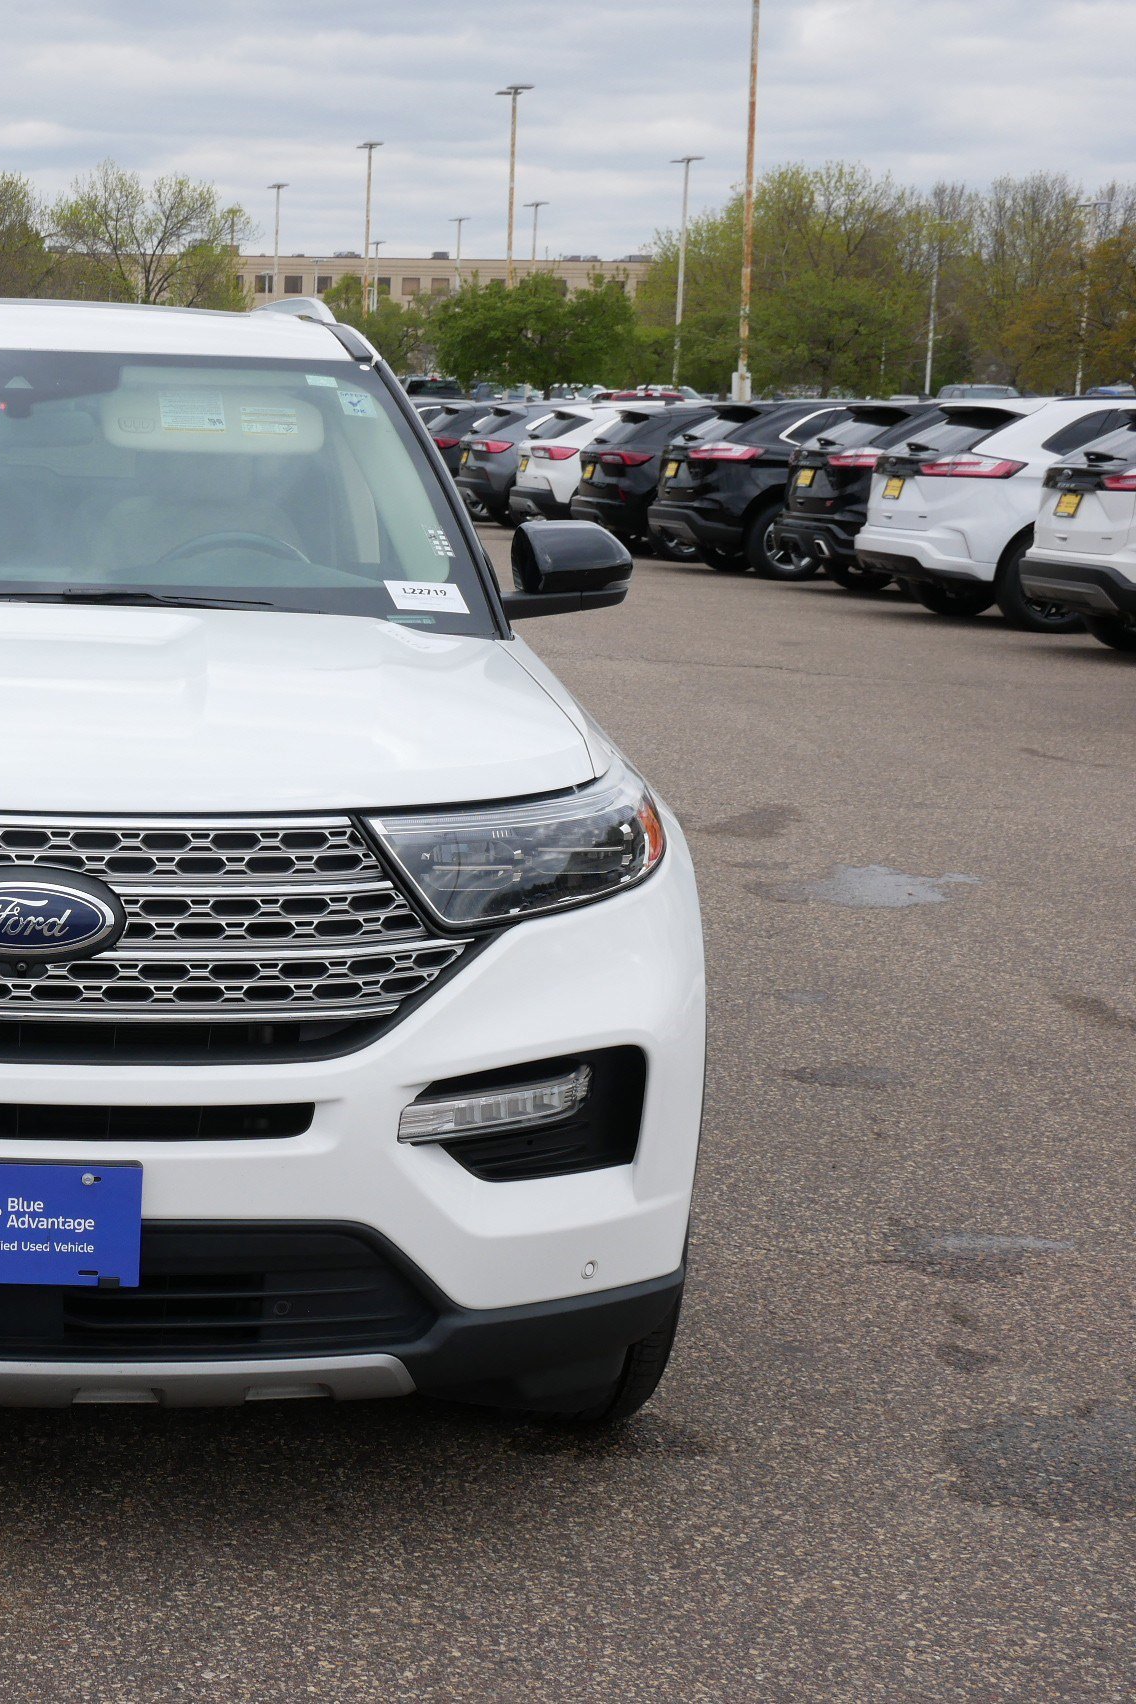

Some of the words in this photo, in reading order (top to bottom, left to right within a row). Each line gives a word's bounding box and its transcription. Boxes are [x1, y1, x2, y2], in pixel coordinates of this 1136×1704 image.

[402, 587, 447, 597] L22719
[7, 1197, 44, 1212] Blue
[6, 1214, 95, 1233] Advantage
[21, 1241, 50, 1252] Used
[53, 1242, 94, 1253] Vehicle
